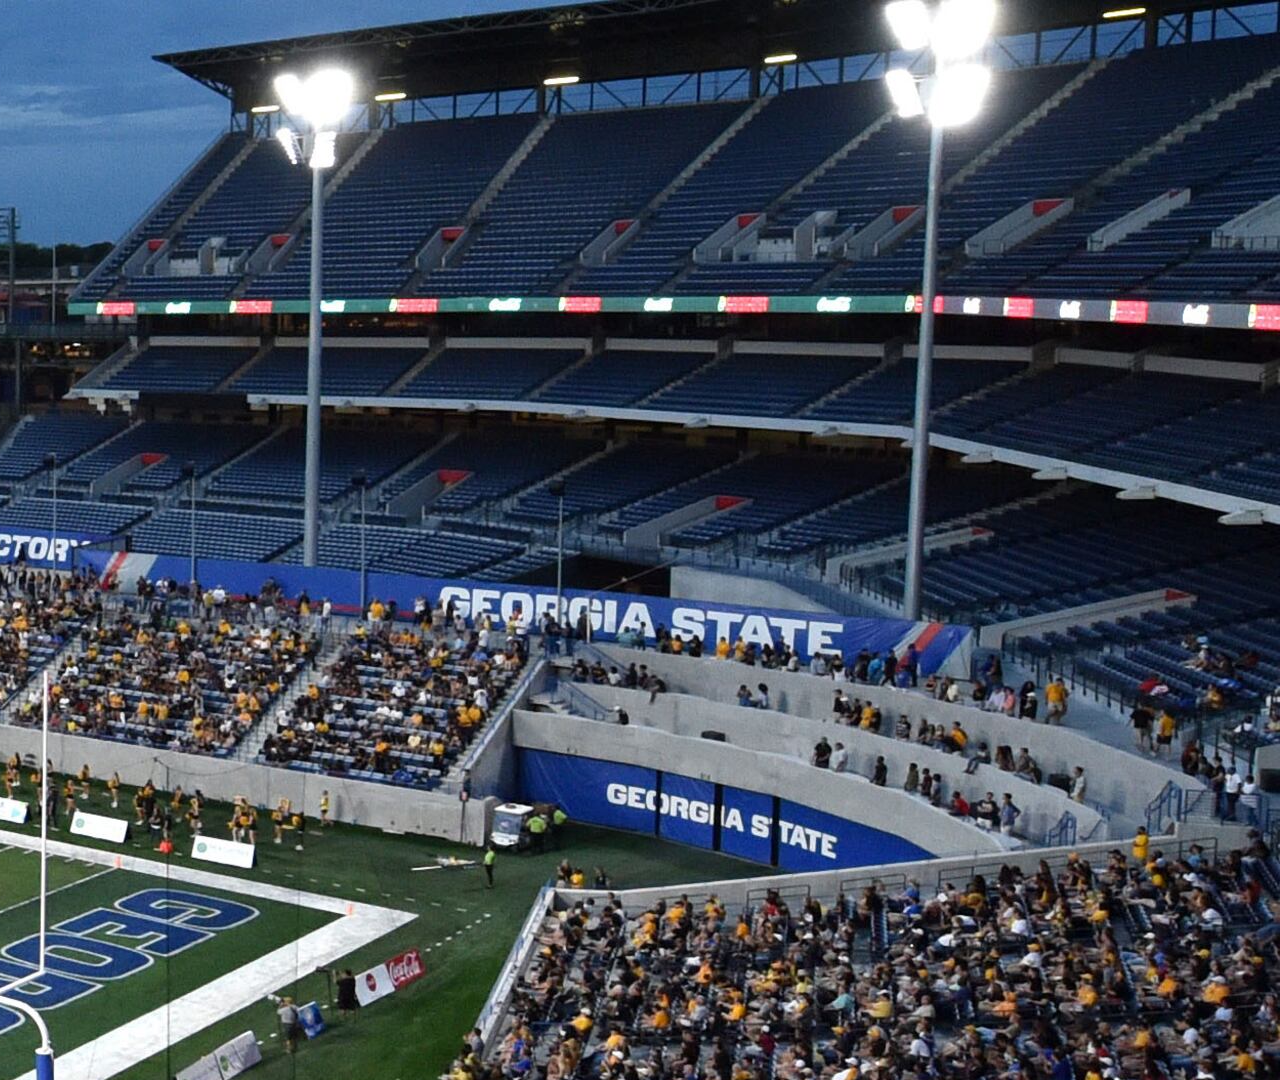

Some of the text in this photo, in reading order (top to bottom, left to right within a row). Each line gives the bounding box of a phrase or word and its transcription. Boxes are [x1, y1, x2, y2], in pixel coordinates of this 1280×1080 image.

[441, 586, 845, 657] GEORGIA STATE
[606, 783, 838, 860] GEORGIA STATE
[391, 951, 424, 986] Coca-Cola
